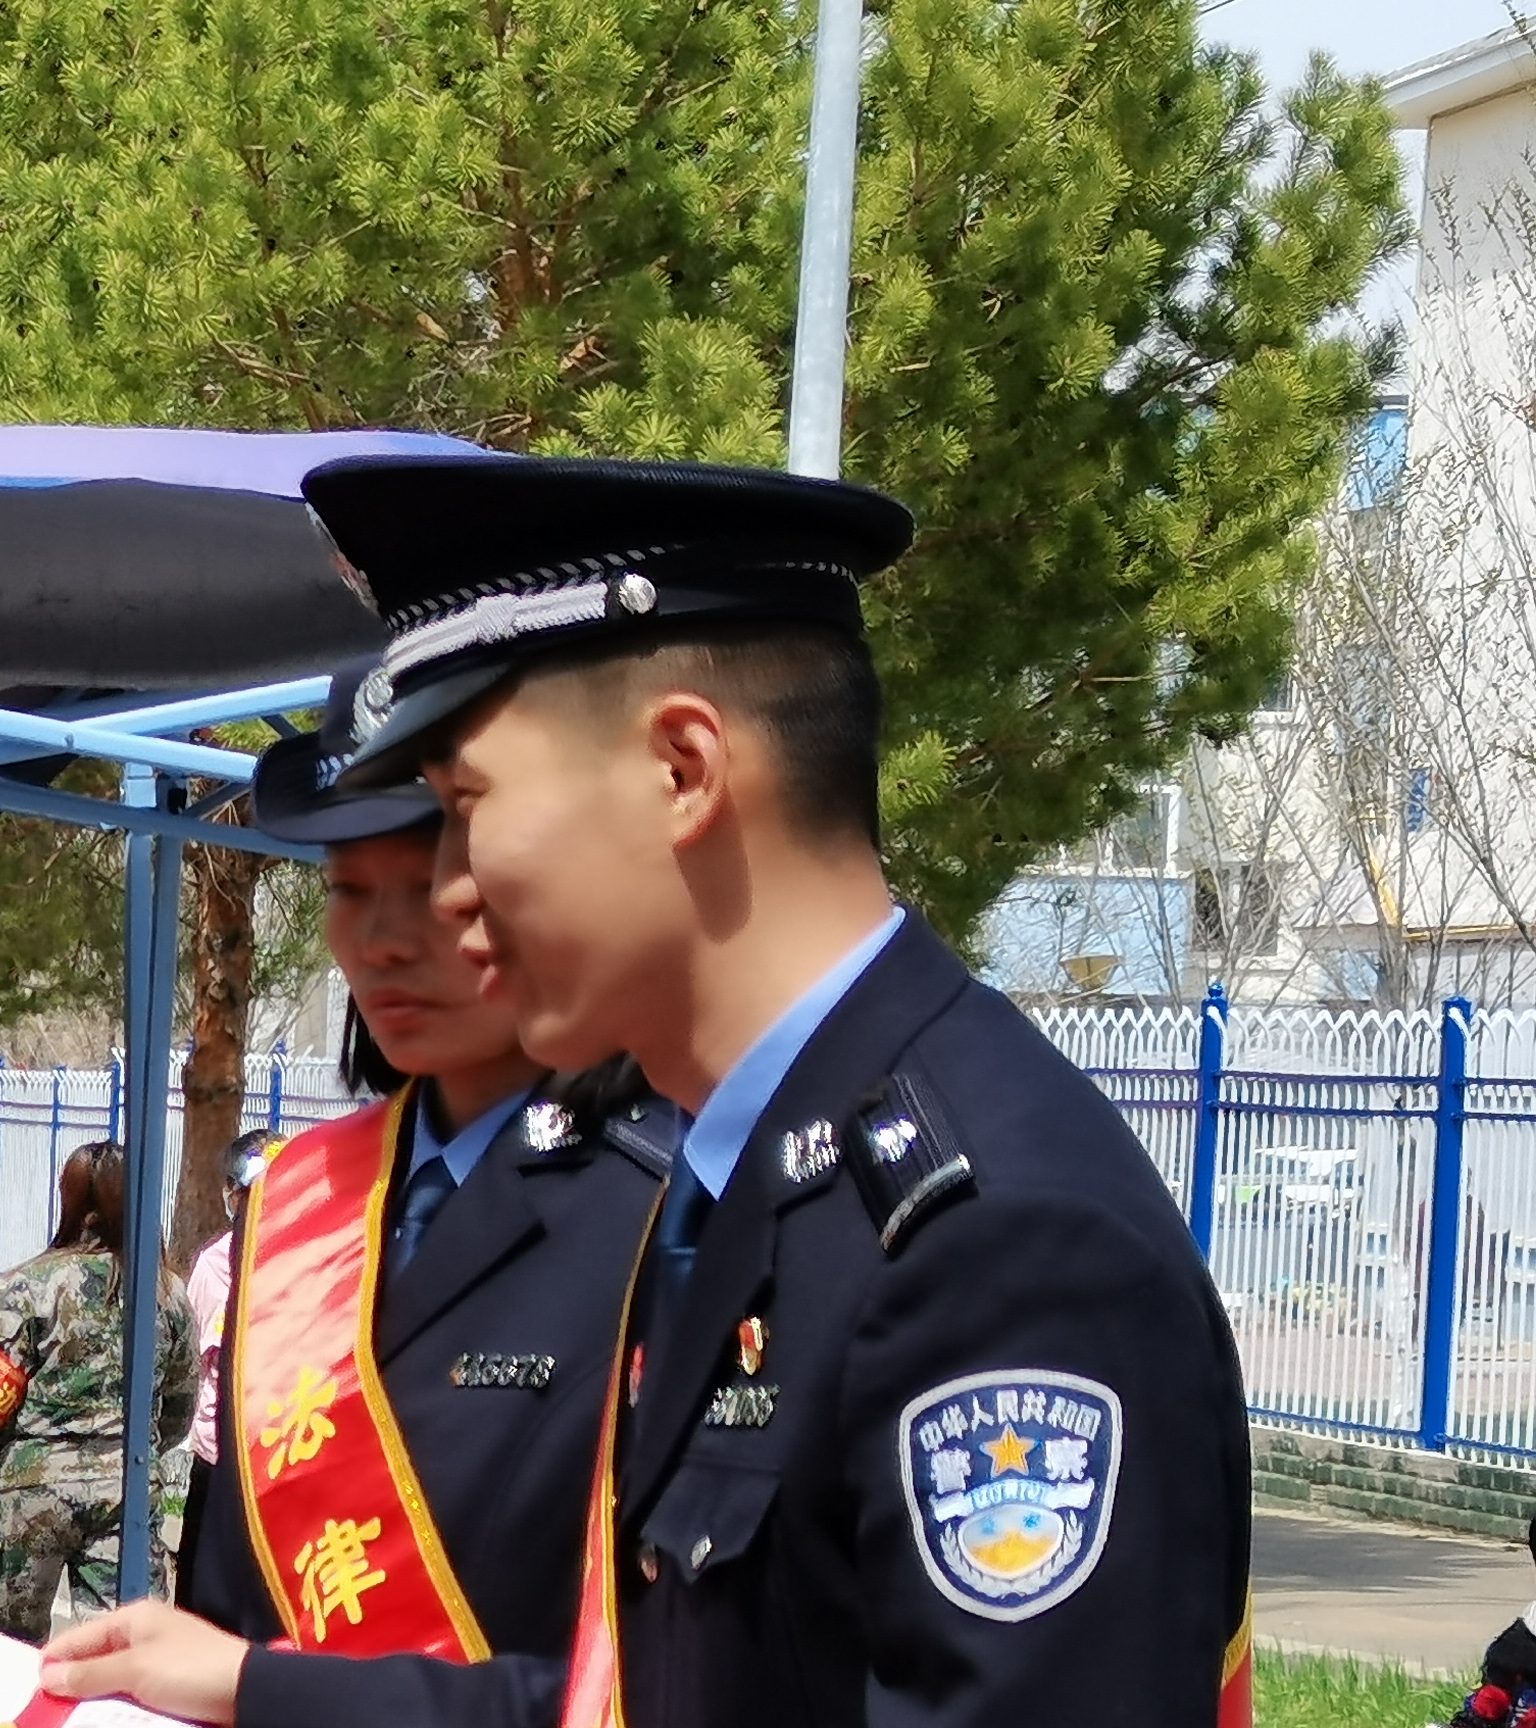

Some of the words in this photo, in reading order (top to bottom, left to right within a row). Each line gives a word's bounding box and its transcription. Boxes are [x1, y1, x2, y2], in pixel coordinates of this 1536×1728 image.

[261, 1366, 386, 1645] 法律
[919, 1388, 1102, 1452] 中华人民共和国
